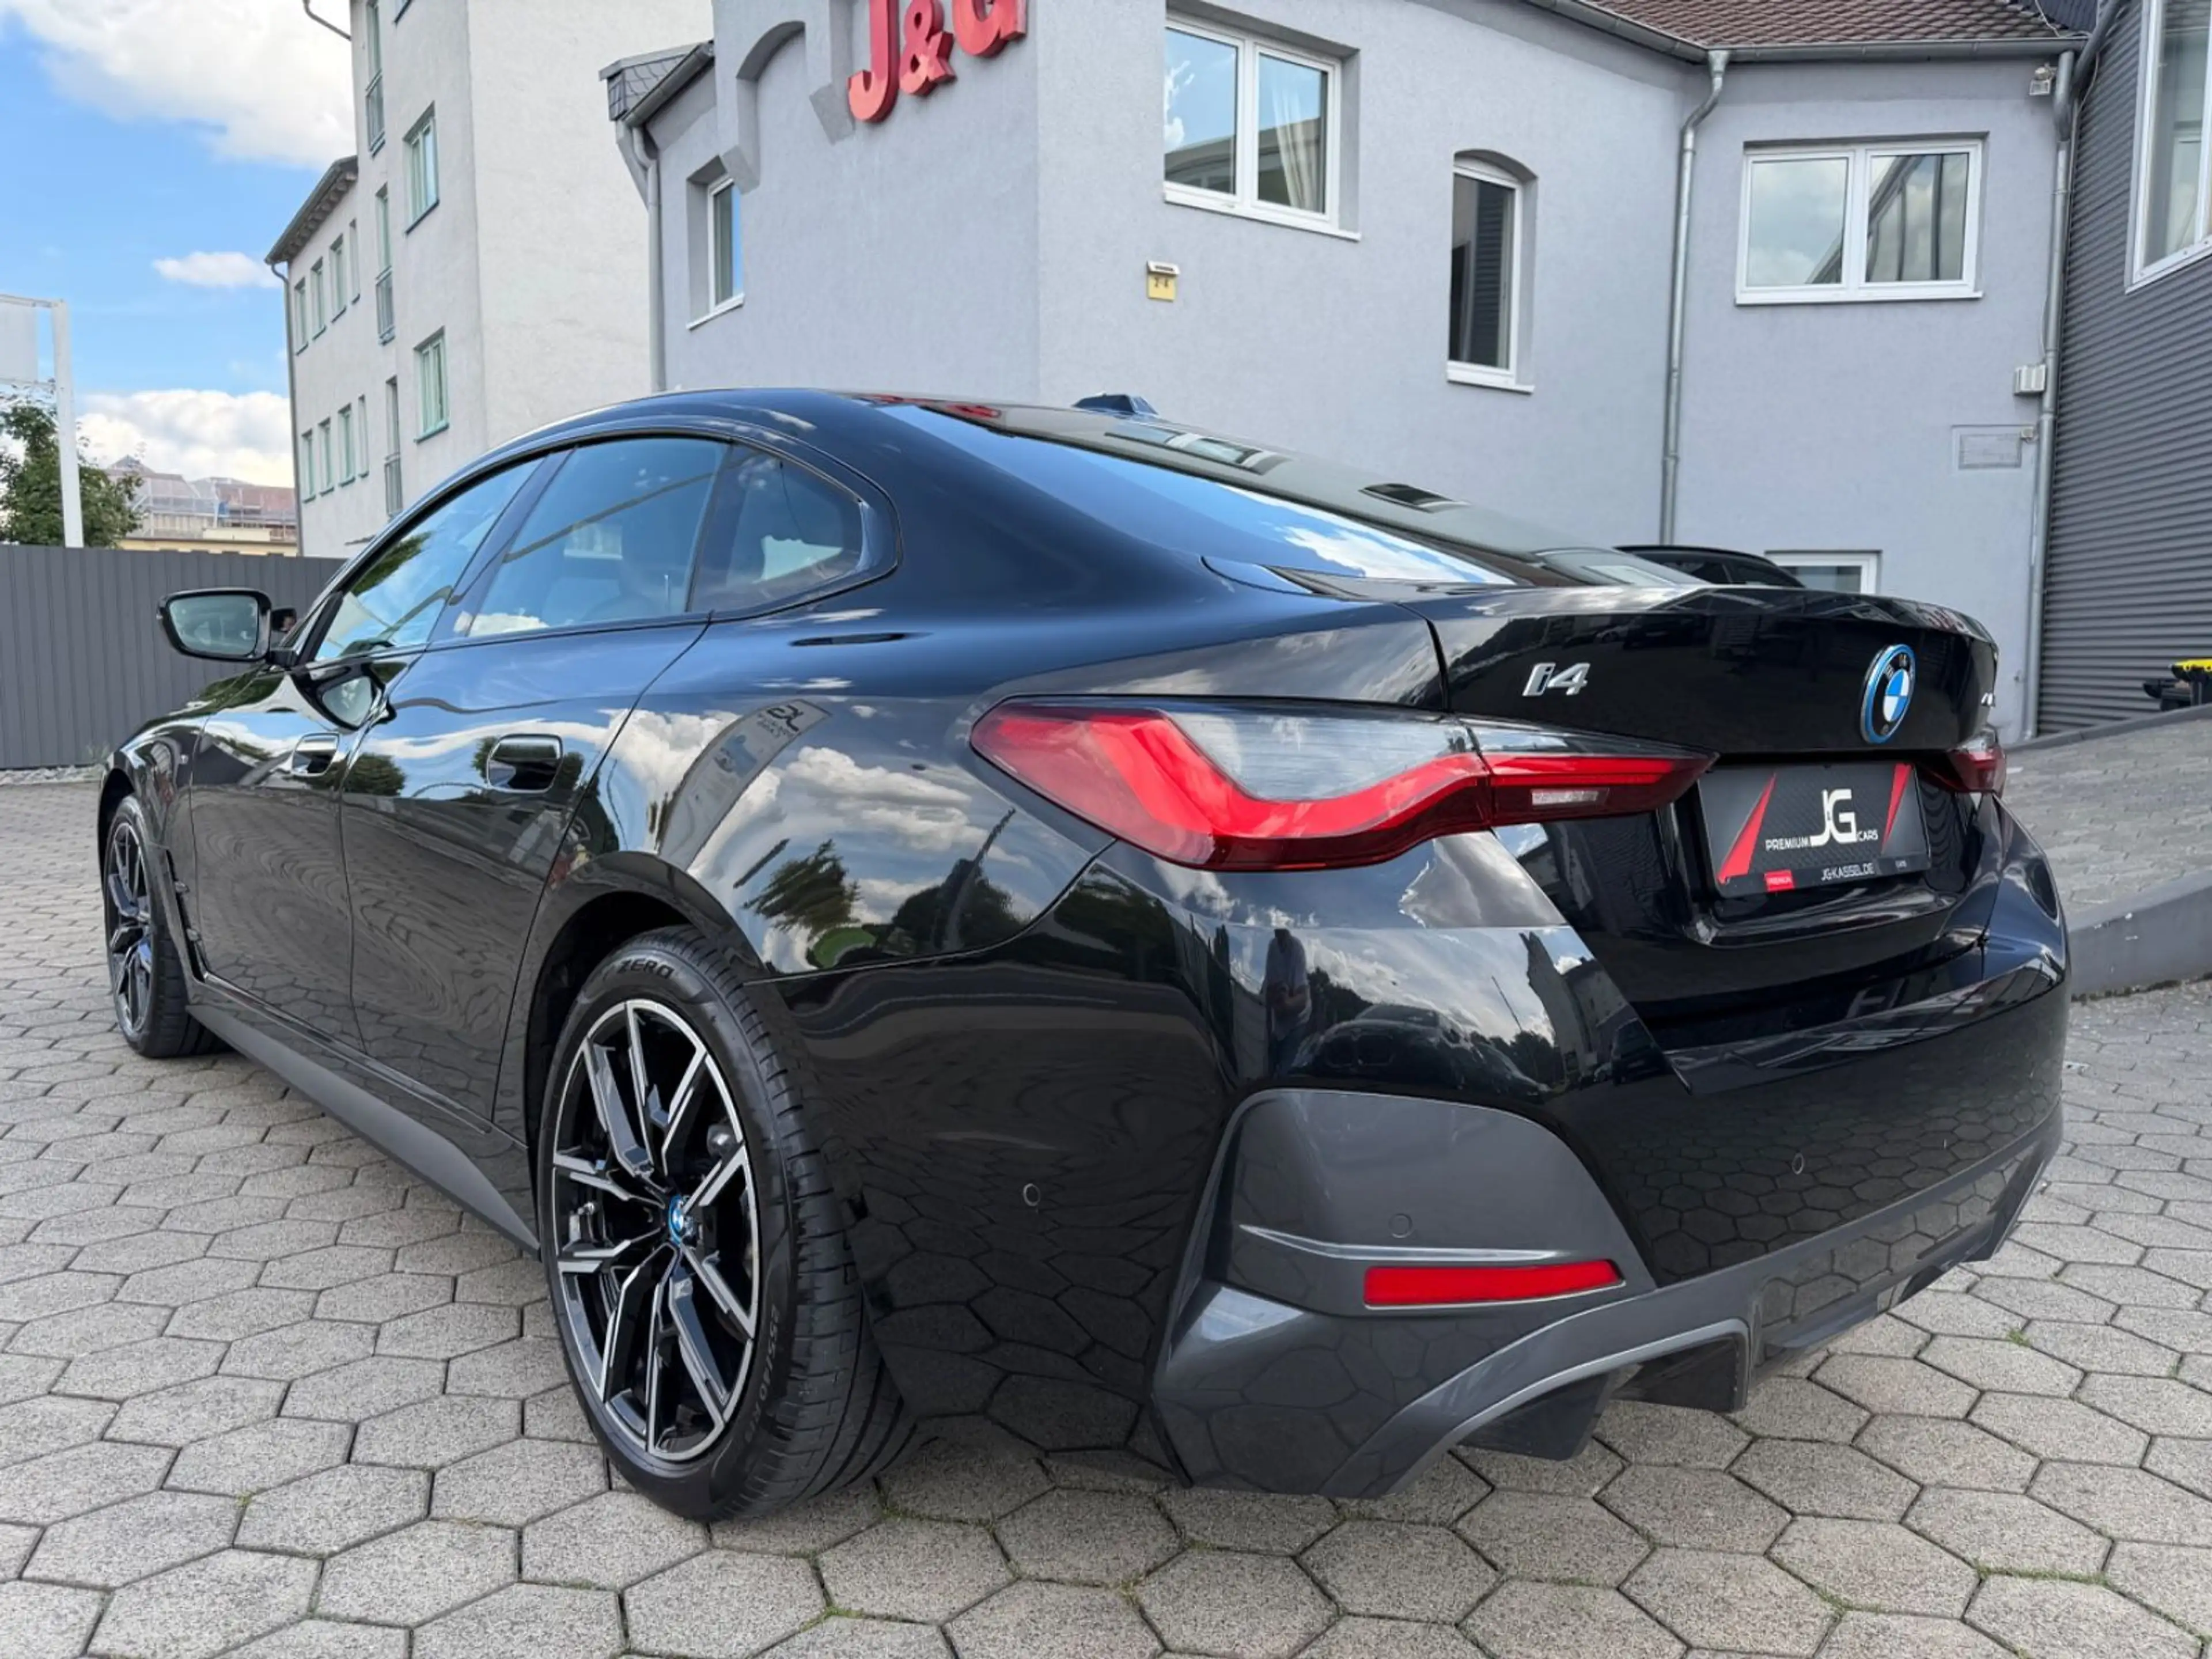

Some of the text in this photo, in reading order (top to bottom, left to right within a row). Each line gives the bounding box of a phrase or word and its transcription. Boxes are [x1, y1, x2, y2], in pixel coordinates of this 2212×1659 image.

[1522, 662, 1591, 696] i4
[1765, 789, 1878, 851] PREMIUM JG CARS
[617, 957, 675, 979] ZERO
